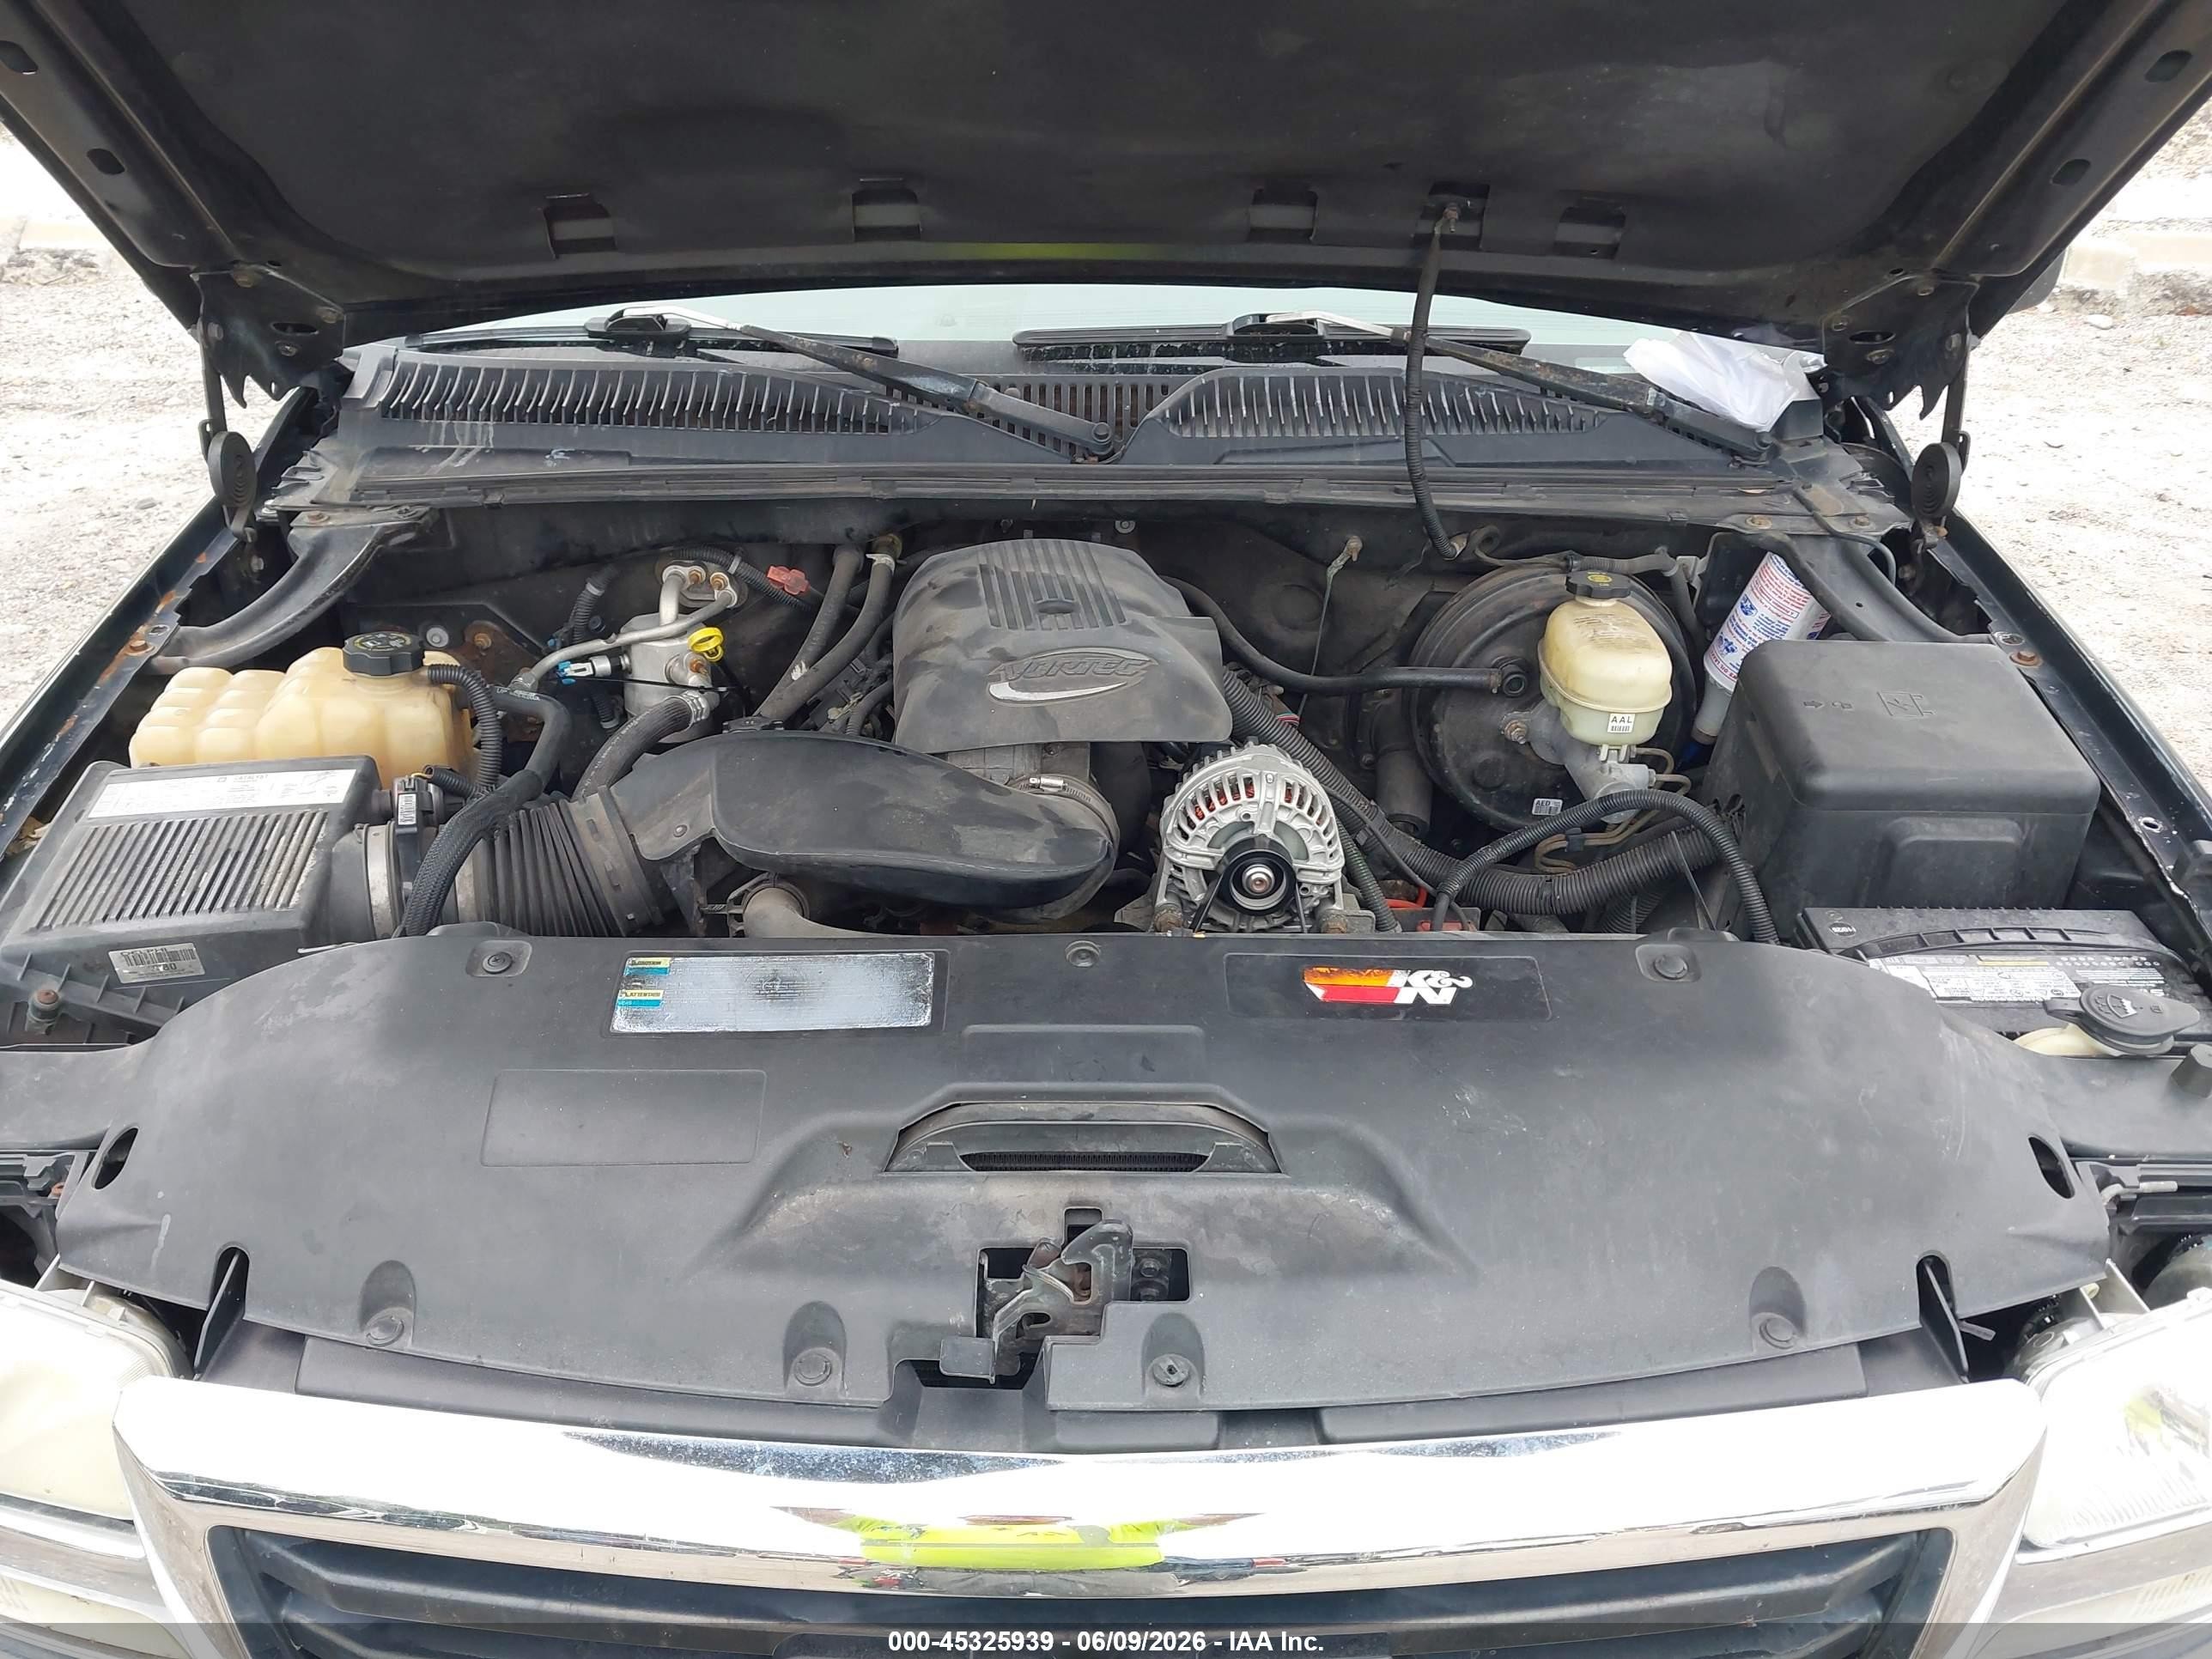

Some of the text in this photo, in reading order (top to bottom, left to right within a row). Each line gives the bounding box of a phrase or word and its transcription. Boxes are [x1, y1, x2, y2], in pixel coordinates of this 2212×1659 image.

[996, 658, 1148, 683] VORTEC
[1610, 715, 1633, 724] AAL
[1386, 969, 1474, 1005] K&N
